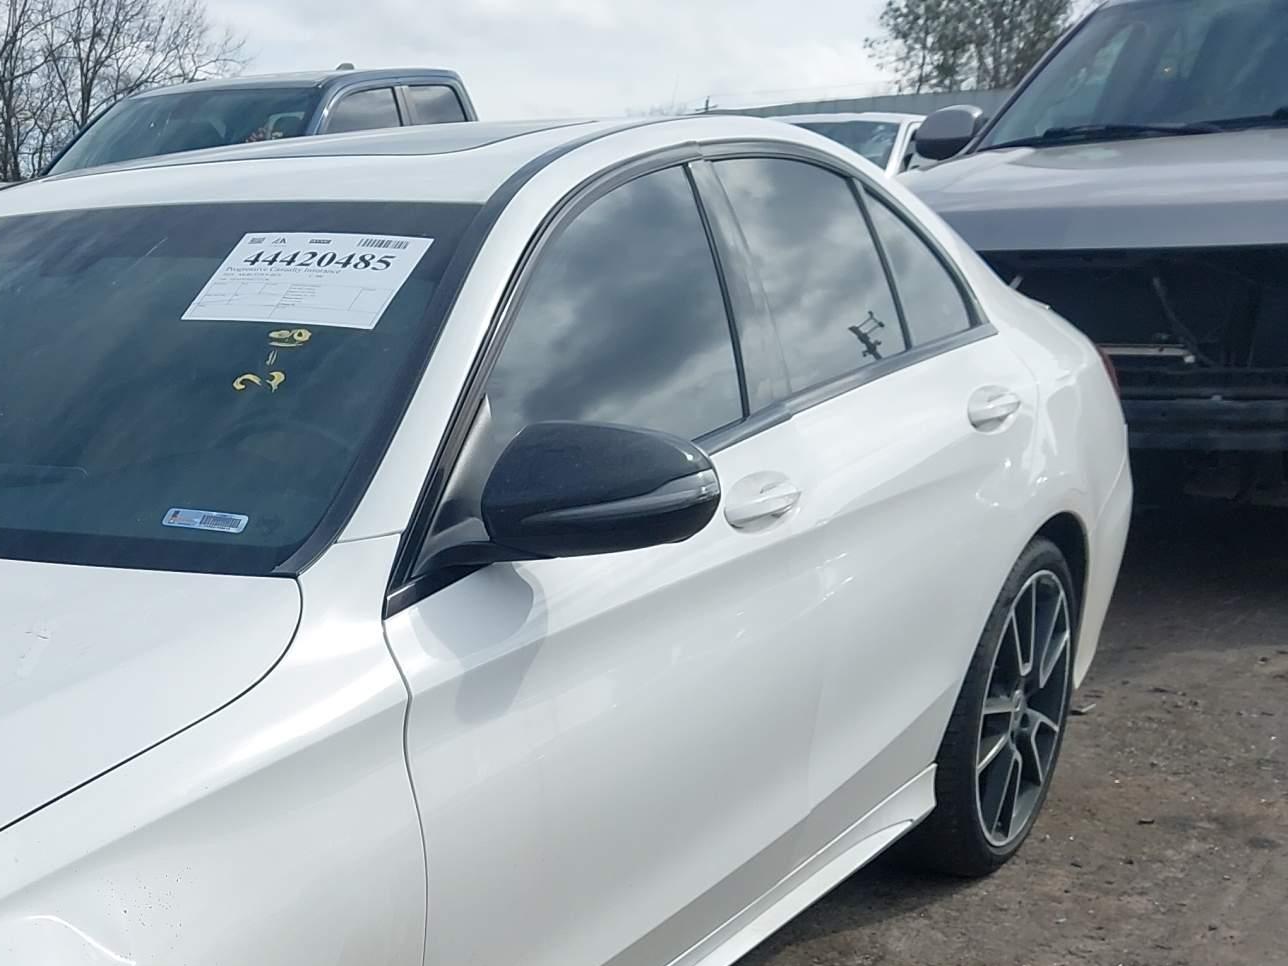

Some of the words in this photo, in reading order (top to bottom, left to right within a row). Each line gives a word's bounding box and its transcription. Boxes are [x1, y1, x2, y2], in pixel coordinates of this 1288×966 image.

[243, 249, 396, 272] 44420485
[225, 265, 268, 274] Progressive
[269, 266, 302, 275] Casualty
[303, 267, 343, 276] Insurance
